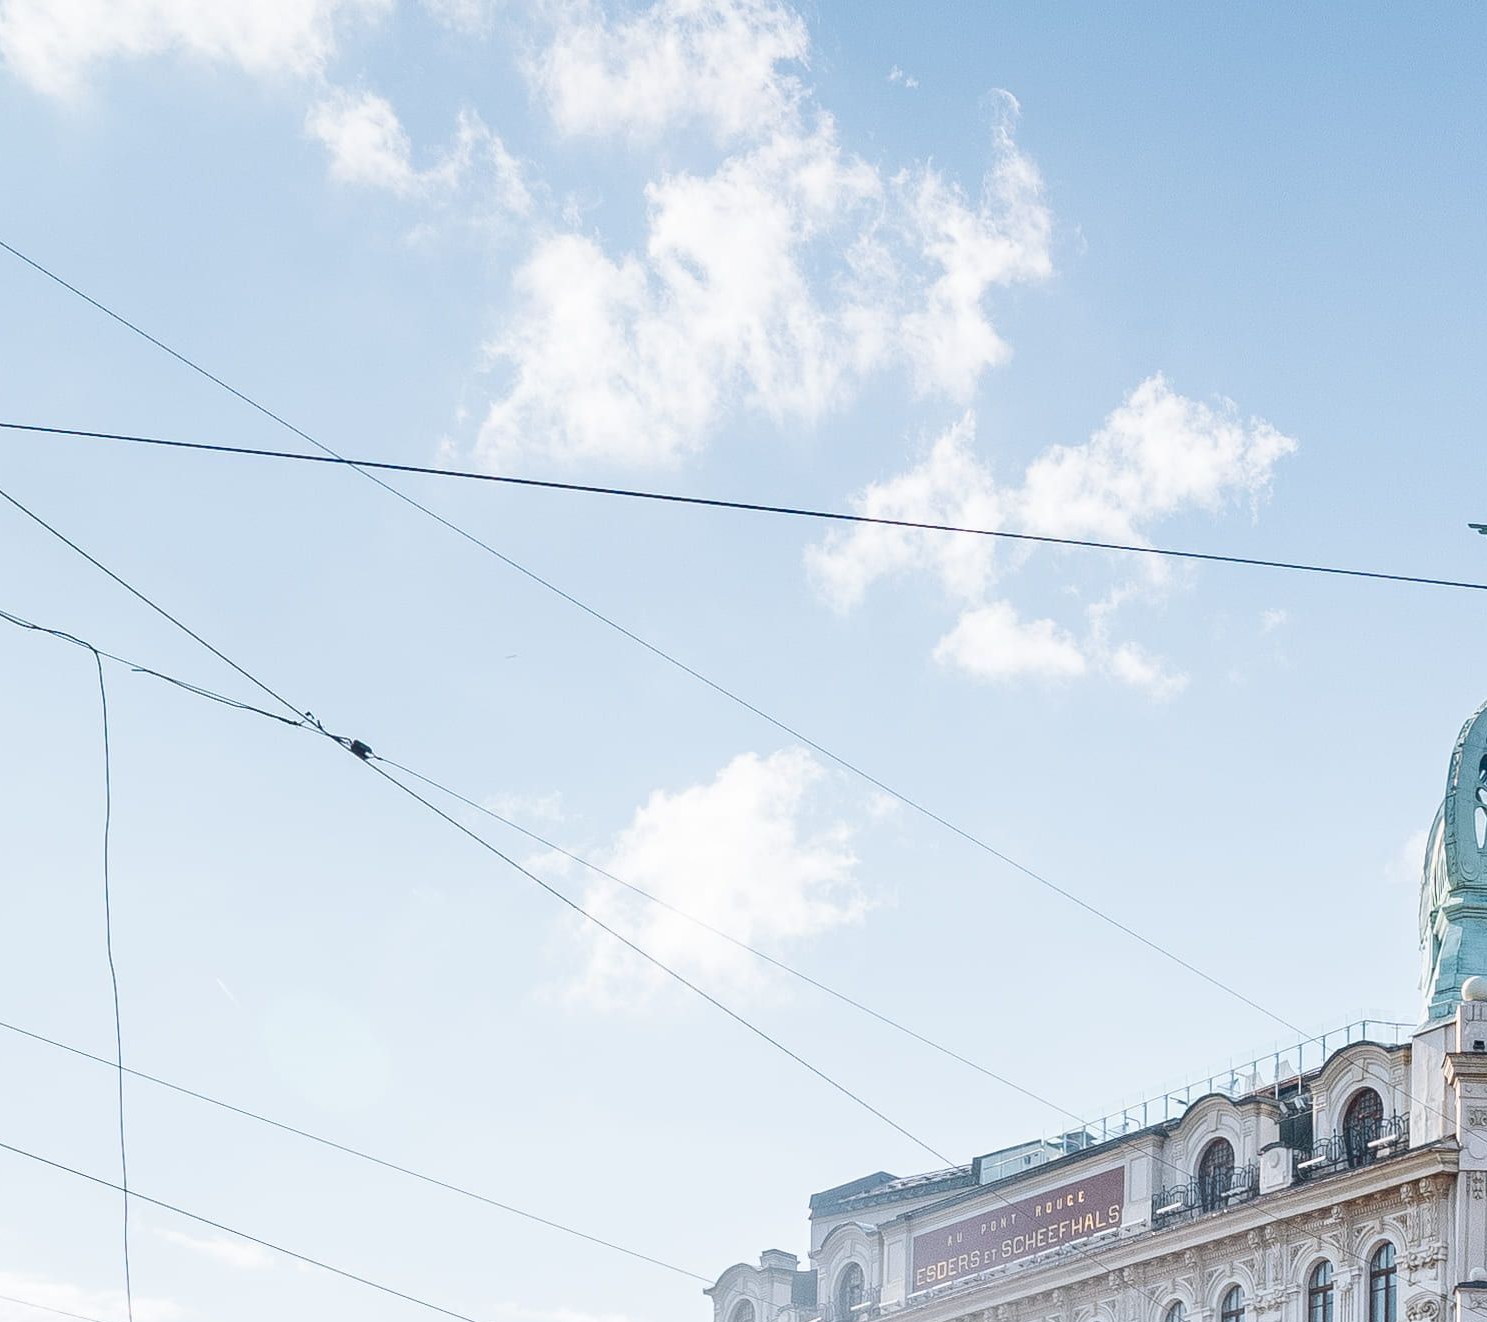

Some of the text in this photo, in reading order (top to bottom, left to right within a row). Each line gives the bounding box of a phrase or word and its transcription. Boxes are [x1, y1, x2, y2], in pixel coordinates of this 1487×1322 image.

[916, 1205, 1120, 1286] ESDERS ET SCHEEFHALS
[947, 1191, 1085, 1248] AU PONT ROUGE
